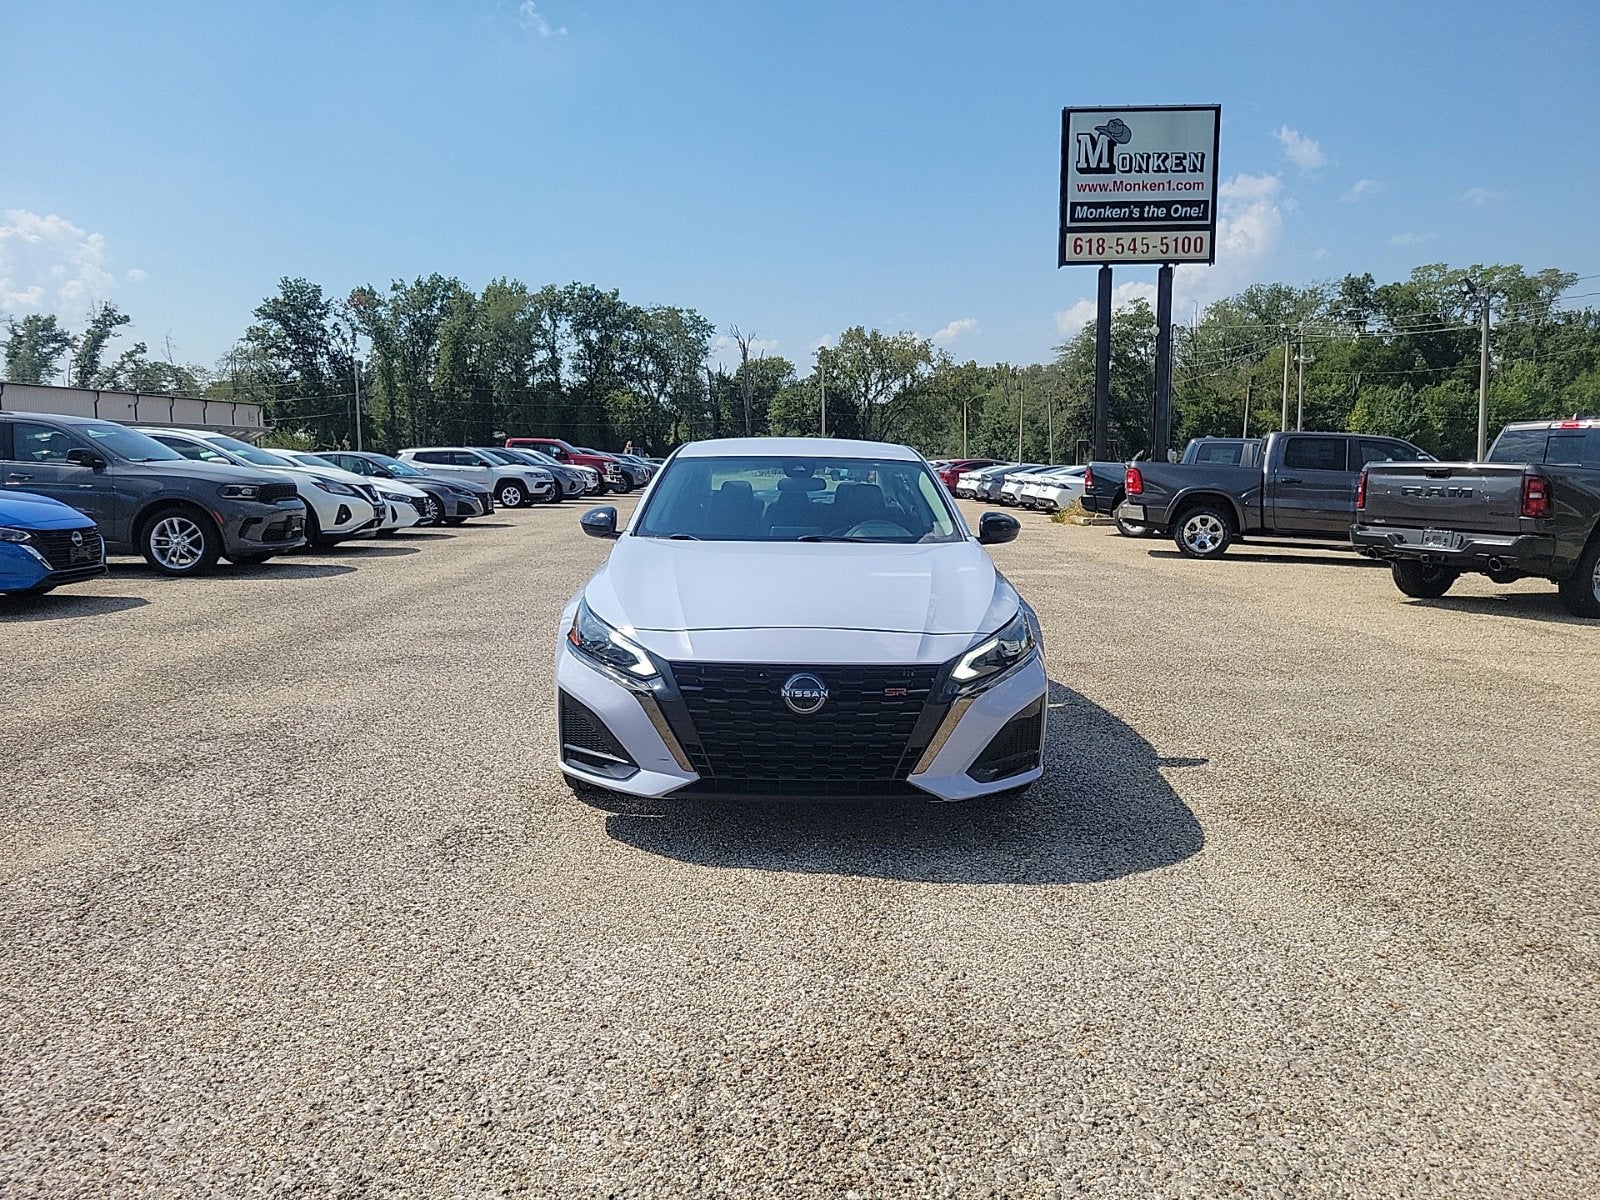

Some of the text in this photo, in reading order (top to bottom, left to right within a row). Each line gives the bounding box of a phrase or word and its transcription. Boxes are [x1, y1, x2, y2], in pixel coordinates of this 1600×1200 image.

[1077, 180, 1204, 193] www.Monken1.com
[1074, 204, 1204, 219] Monken's the One!
[1073, 236, 1204, 255] 618-545-5100
[1401, 485, 1473, 498] RAM
[781, 689, 829, 697] NISSAN
[885, 688, 907, 696] SR
